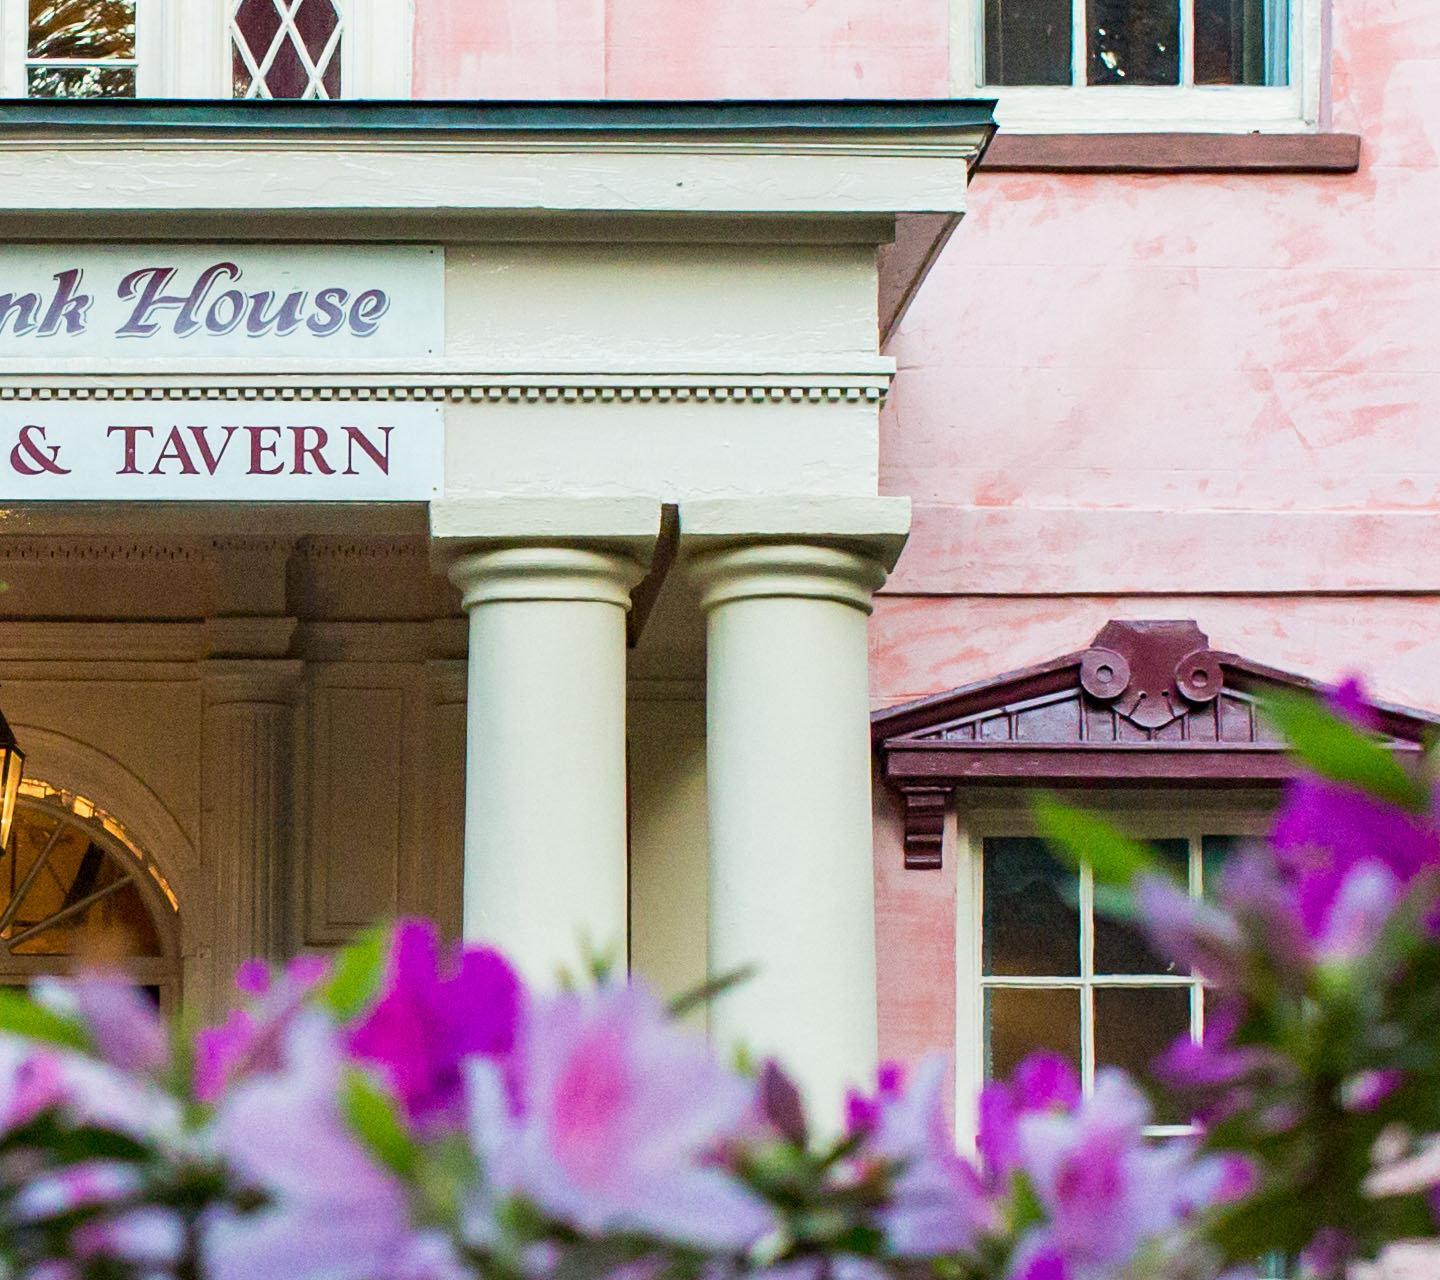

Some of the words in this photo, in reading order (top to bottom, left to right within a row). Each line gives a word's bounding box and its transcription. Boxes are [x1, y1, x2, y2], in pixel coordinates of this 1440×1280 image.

[114, 261, 391, 338] House
[10, 425, 72, 476] &
[107, 425, 395, 476] TAVERN
